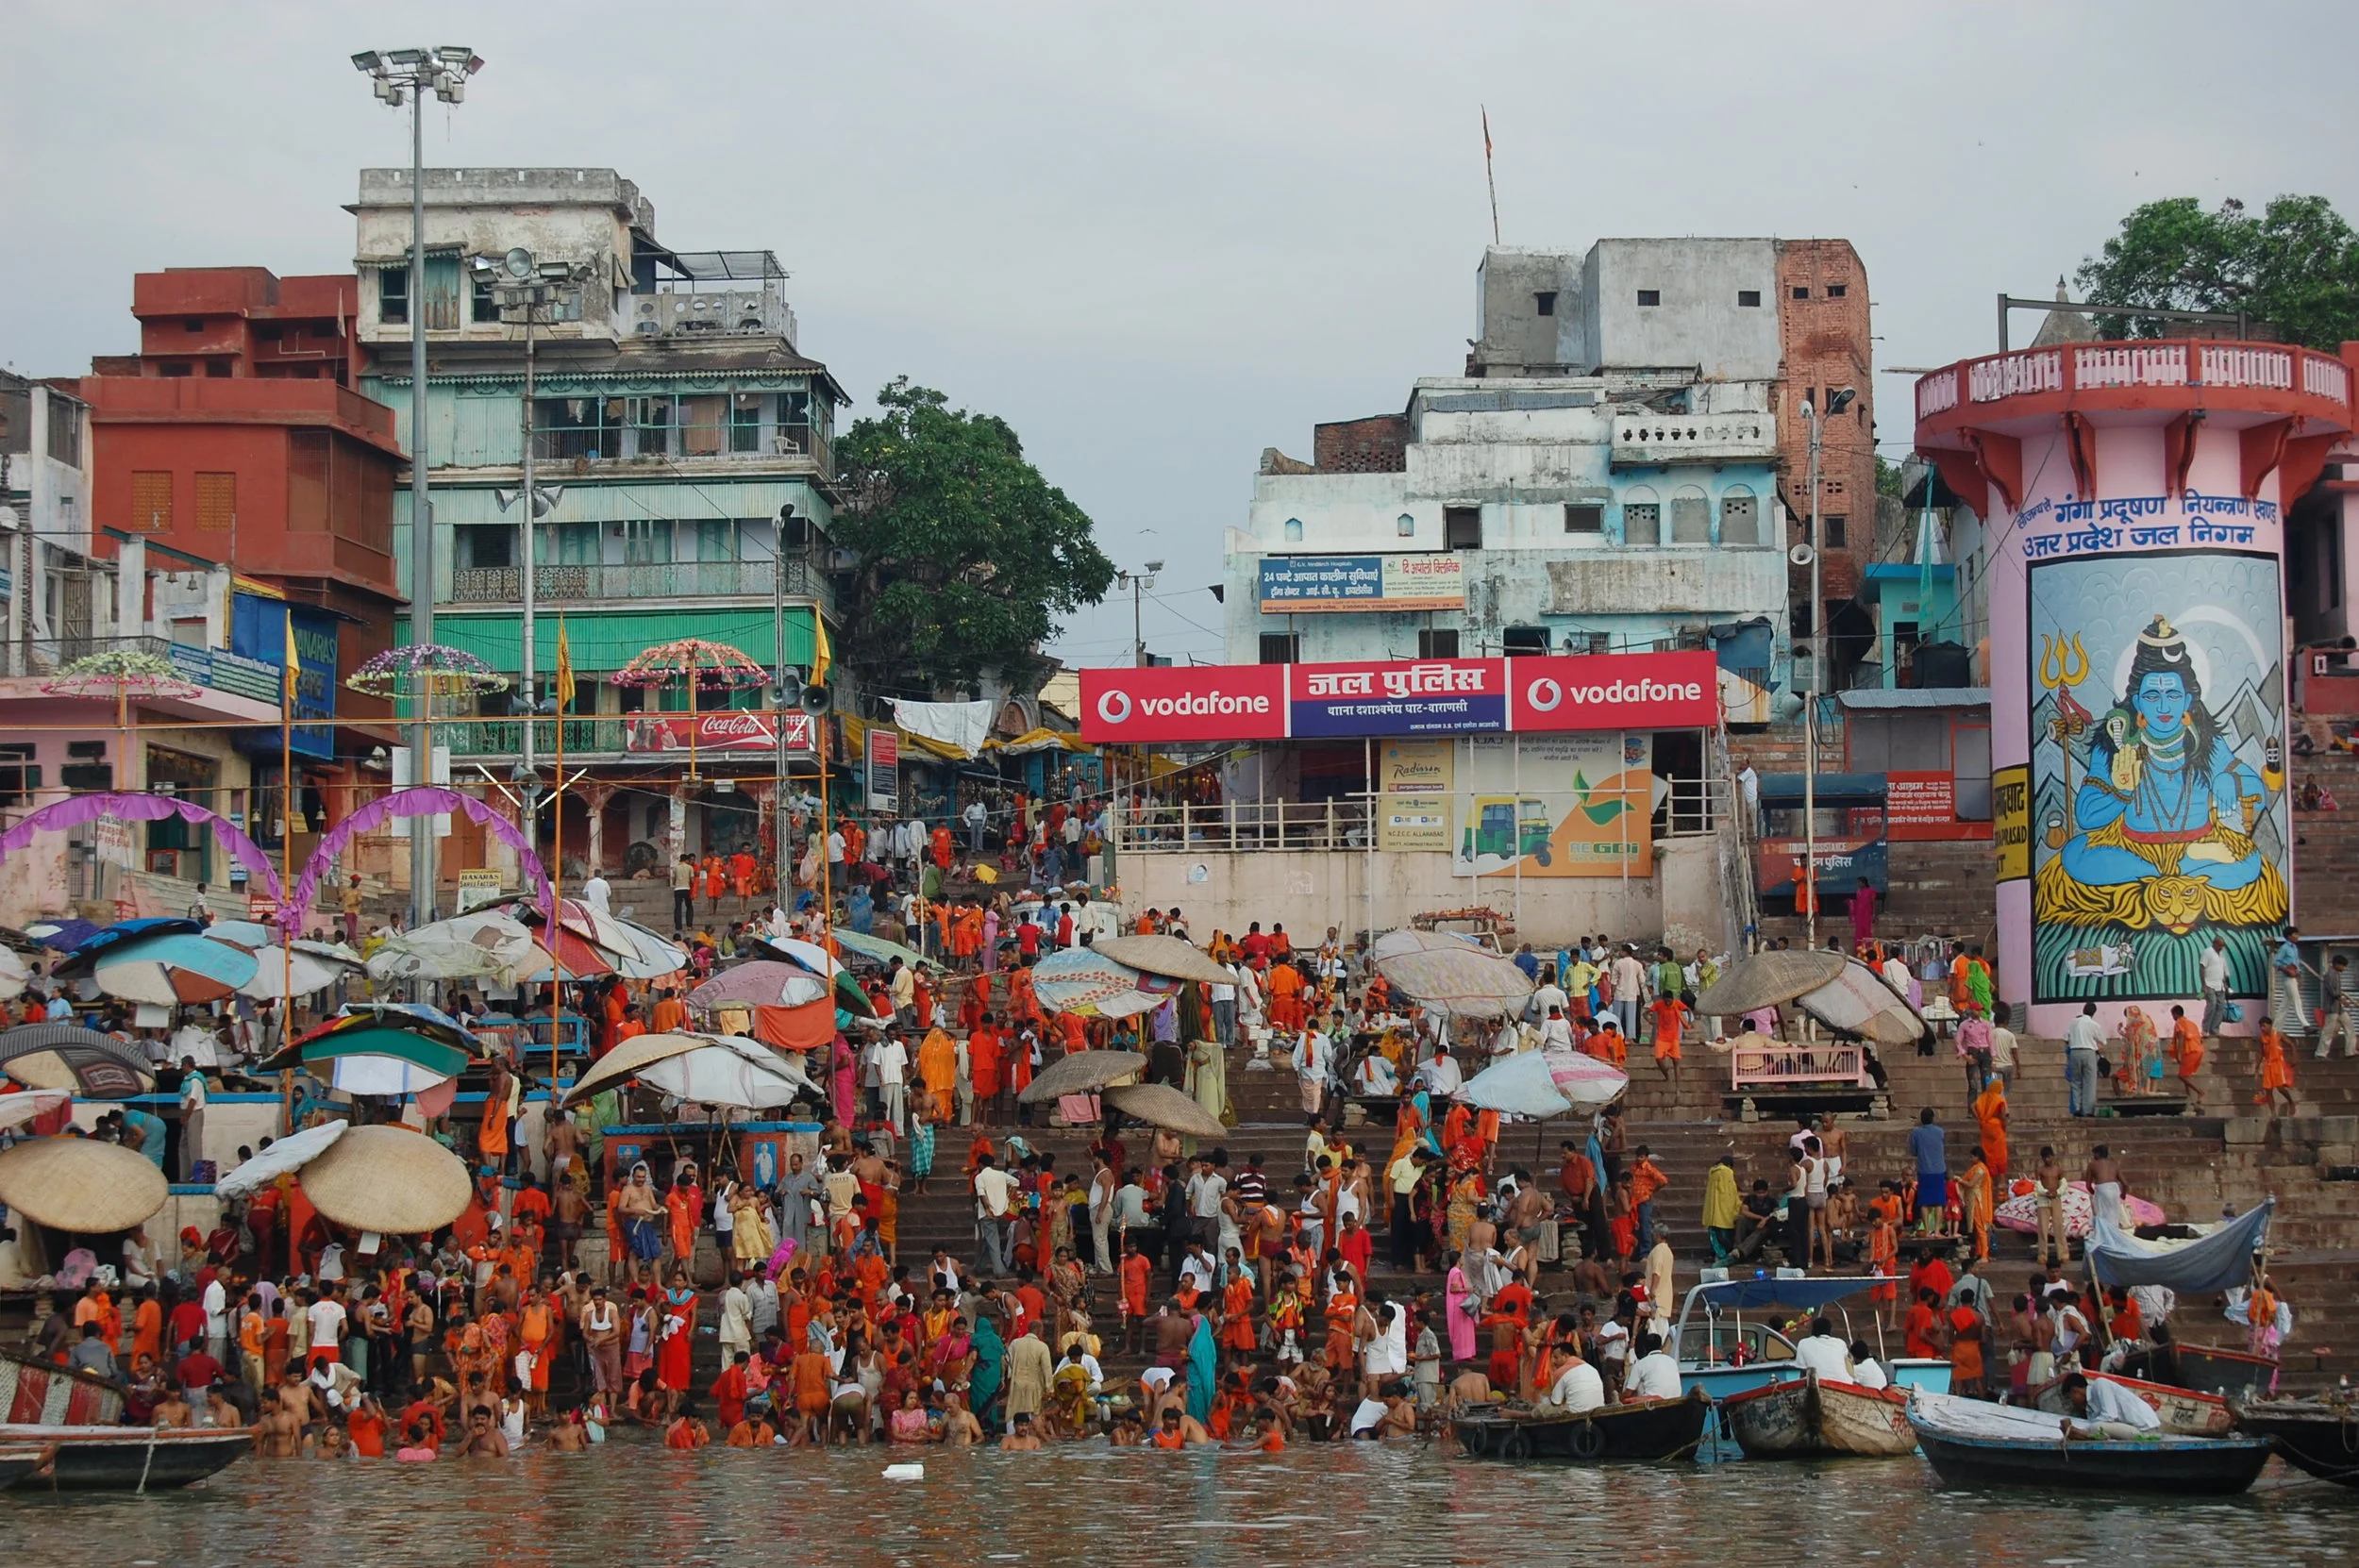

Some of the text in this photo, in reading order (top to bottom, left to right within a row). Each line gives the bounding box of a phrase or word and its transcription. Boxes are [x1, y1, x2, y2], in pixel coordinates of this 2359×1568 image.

[2054, 493, 2096, 523] गंगा
[2099, 497, 2167, 524] प्रदूषण
[2254, 499, 2277, 525] खण्ड
[2022, 516, 2255, 558] उत्तर प्रदेश जल निगम
[1264, 572, 1275, 582] 24
[1294, 572, 1318, 581] आपात
[1320, 568, 1347, 581] कालीन
[294, 628, 337, 664] ANARAS
[1309, 664, 1486, 698] जल पुलिस
[1570, 677, 1701, 705] vodafone
[1140, 691, 1269, 716] vodafone
[1393, 762, 1441, 779] Radisson
[1825, 854, 1853, 871] पुलिस
